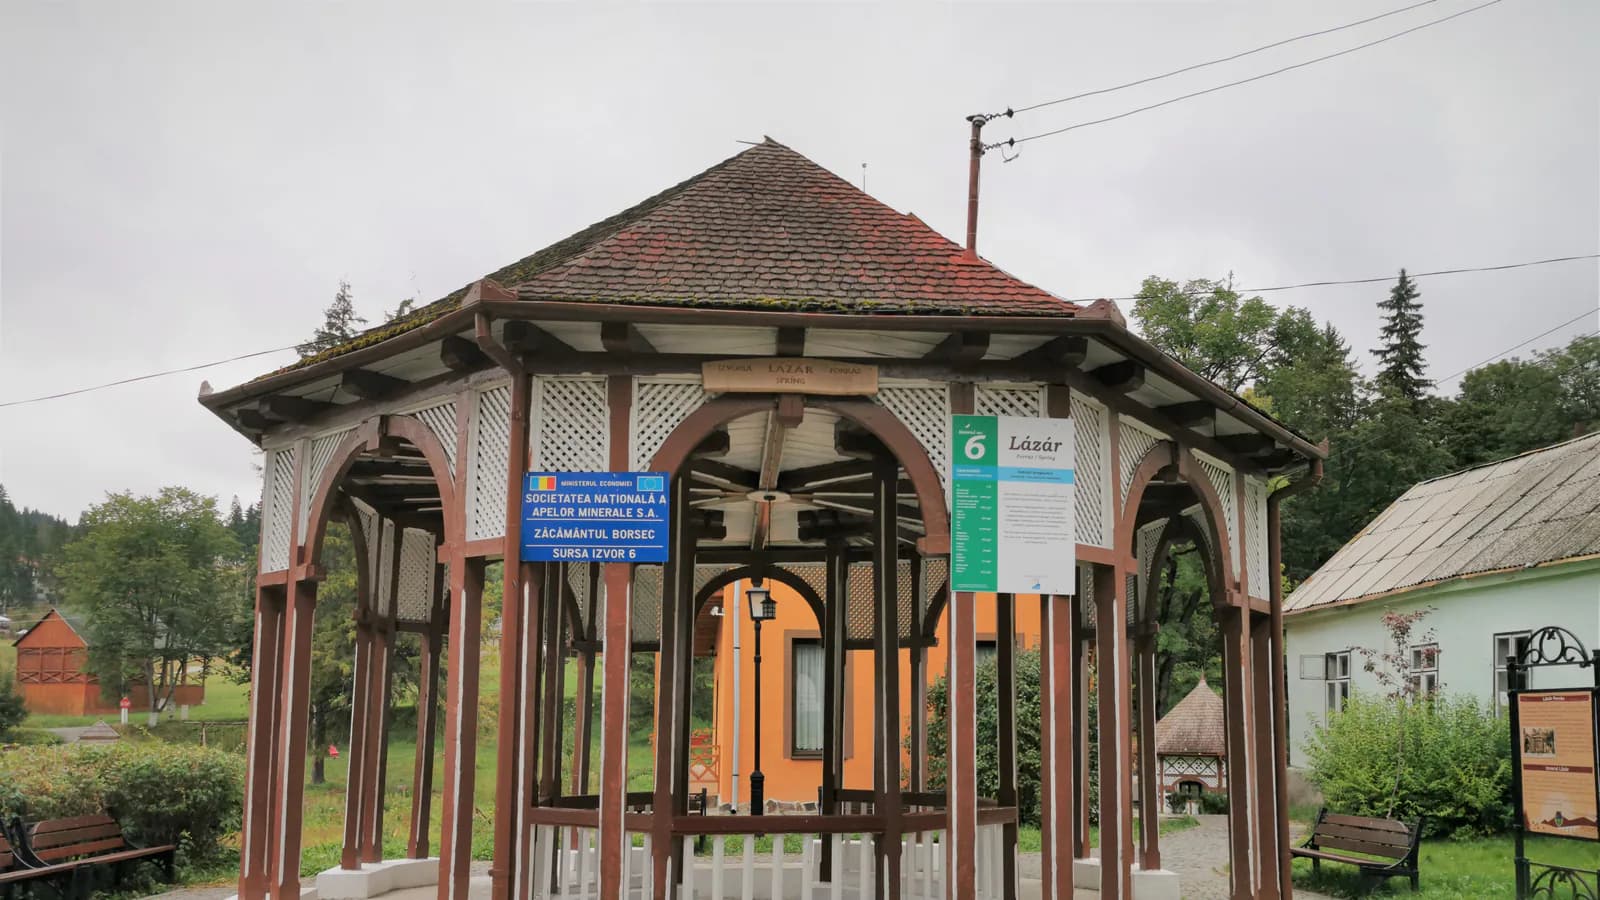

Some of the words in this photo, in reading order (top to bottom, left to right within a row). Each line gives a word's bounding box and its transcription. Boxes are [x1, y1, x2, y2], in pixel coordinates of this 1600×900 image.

[965, 434, 987, 461] 6
[1008, 435, 1063, 453] Lázár
[525, 494, 592, 504] SOCIETATEA
[658, 495, 667, 505] A
[532, 507, 575, 517] APELOR
[578, 507, 633, 518] MINERALE
[636, 508, 659, 518] S.A.
[612, 529, 655, 540] BORSEC
[552, 548, 589, 559] SURSA
[592, 549, 625, 559] IZVOR
[628, 549, 637, 559] 6
